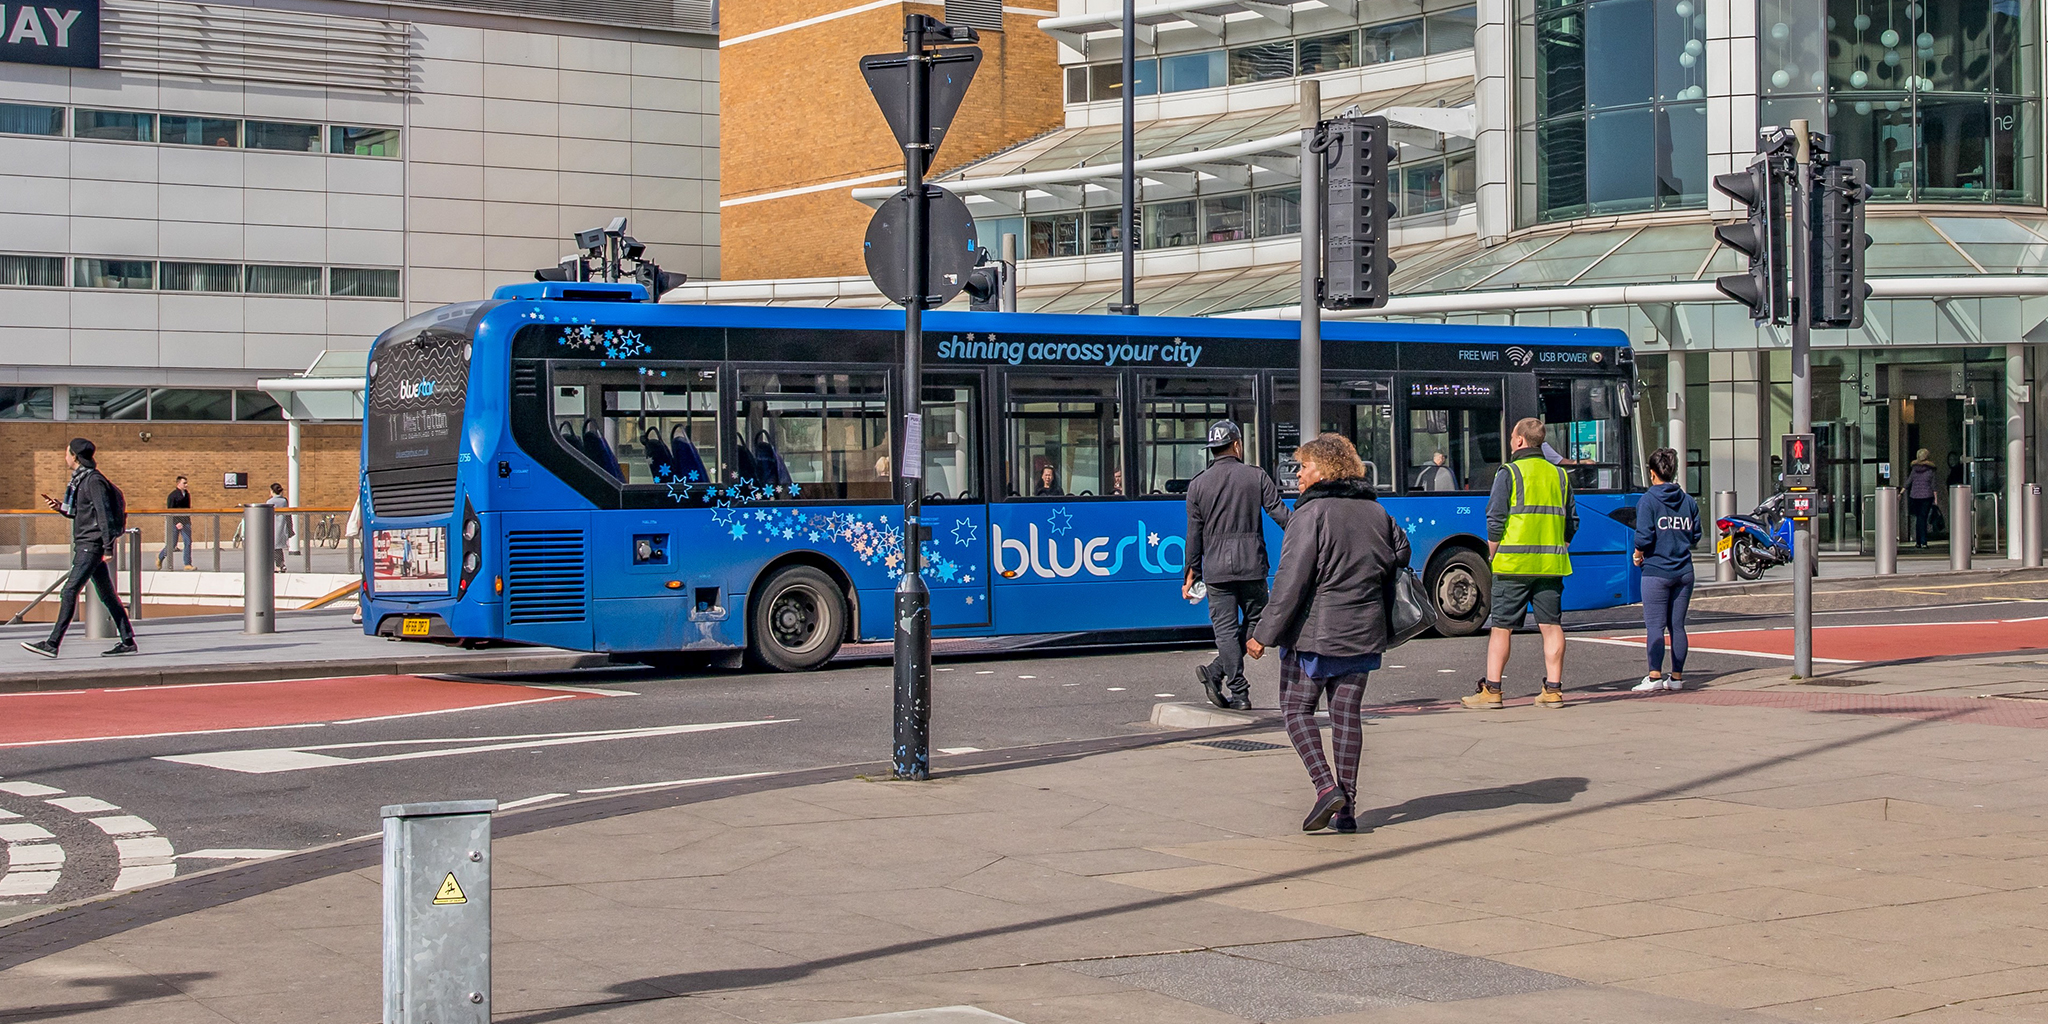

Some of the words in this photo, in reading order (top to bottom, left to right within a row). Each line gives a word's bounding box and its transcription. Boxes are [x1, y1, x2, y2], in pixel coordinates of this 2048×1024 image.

[0, 4, 82, 48] AY
[937, 332, 1024, 365] shining
[1028, 341, 1103, 360] across
[1105, 343, 1158, 367] your
[1161, 337, 1202, 367] city
[1458, 350, 1480, 361] FREE
[1481, 350, 1499, 361] WIFI
[1539, 352, 1556, 363] USB
[1557, 352, 1588, 363] POWER
[400, 377, 436, 399] bluestar
[1456, 506, 1471, 515] 2756
[1657, 516, 1693, 531] CREW
